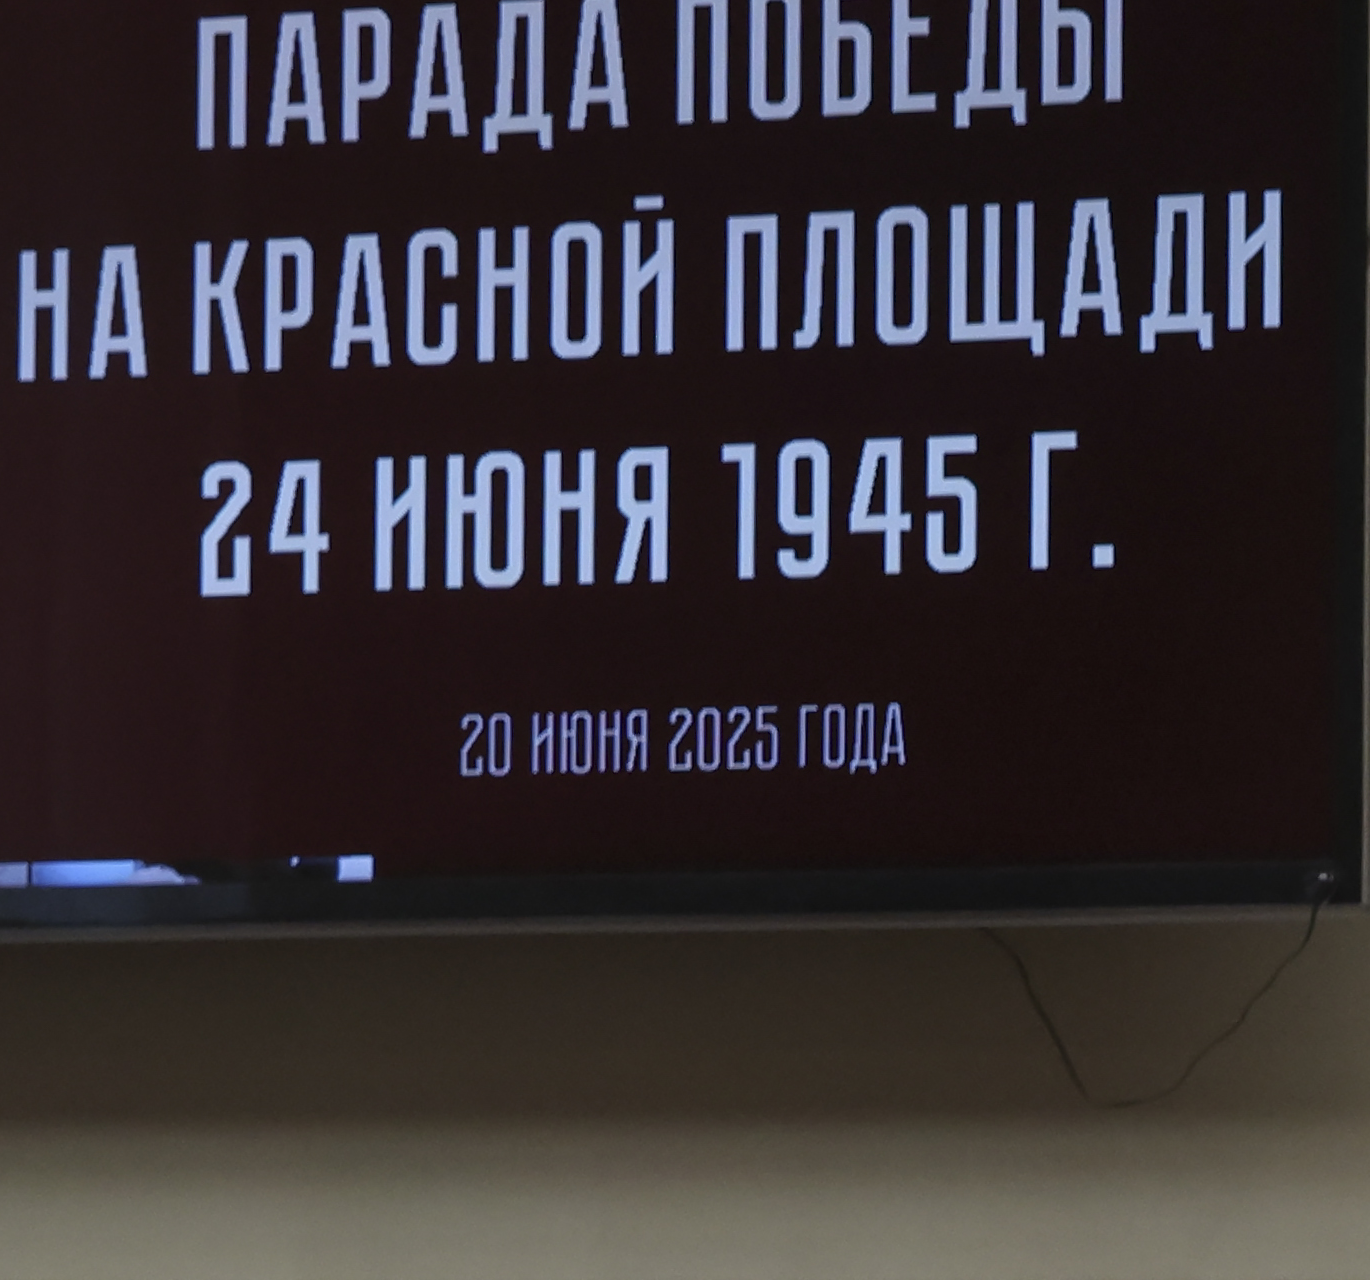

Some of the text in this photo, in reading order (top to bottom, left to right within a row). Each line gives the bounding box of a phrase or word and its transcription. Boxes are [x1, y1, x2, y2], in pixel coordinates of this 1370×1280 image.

[16, 189, 1282, 383] НА КРАСНОЙ ПЛОЩАДИ
[198, 430, 1115, 598] 24 ИЮНЯ 1945 Г.
[459, 701, 906, 778] 20 ИЮНЯ 2025 ГОДА
